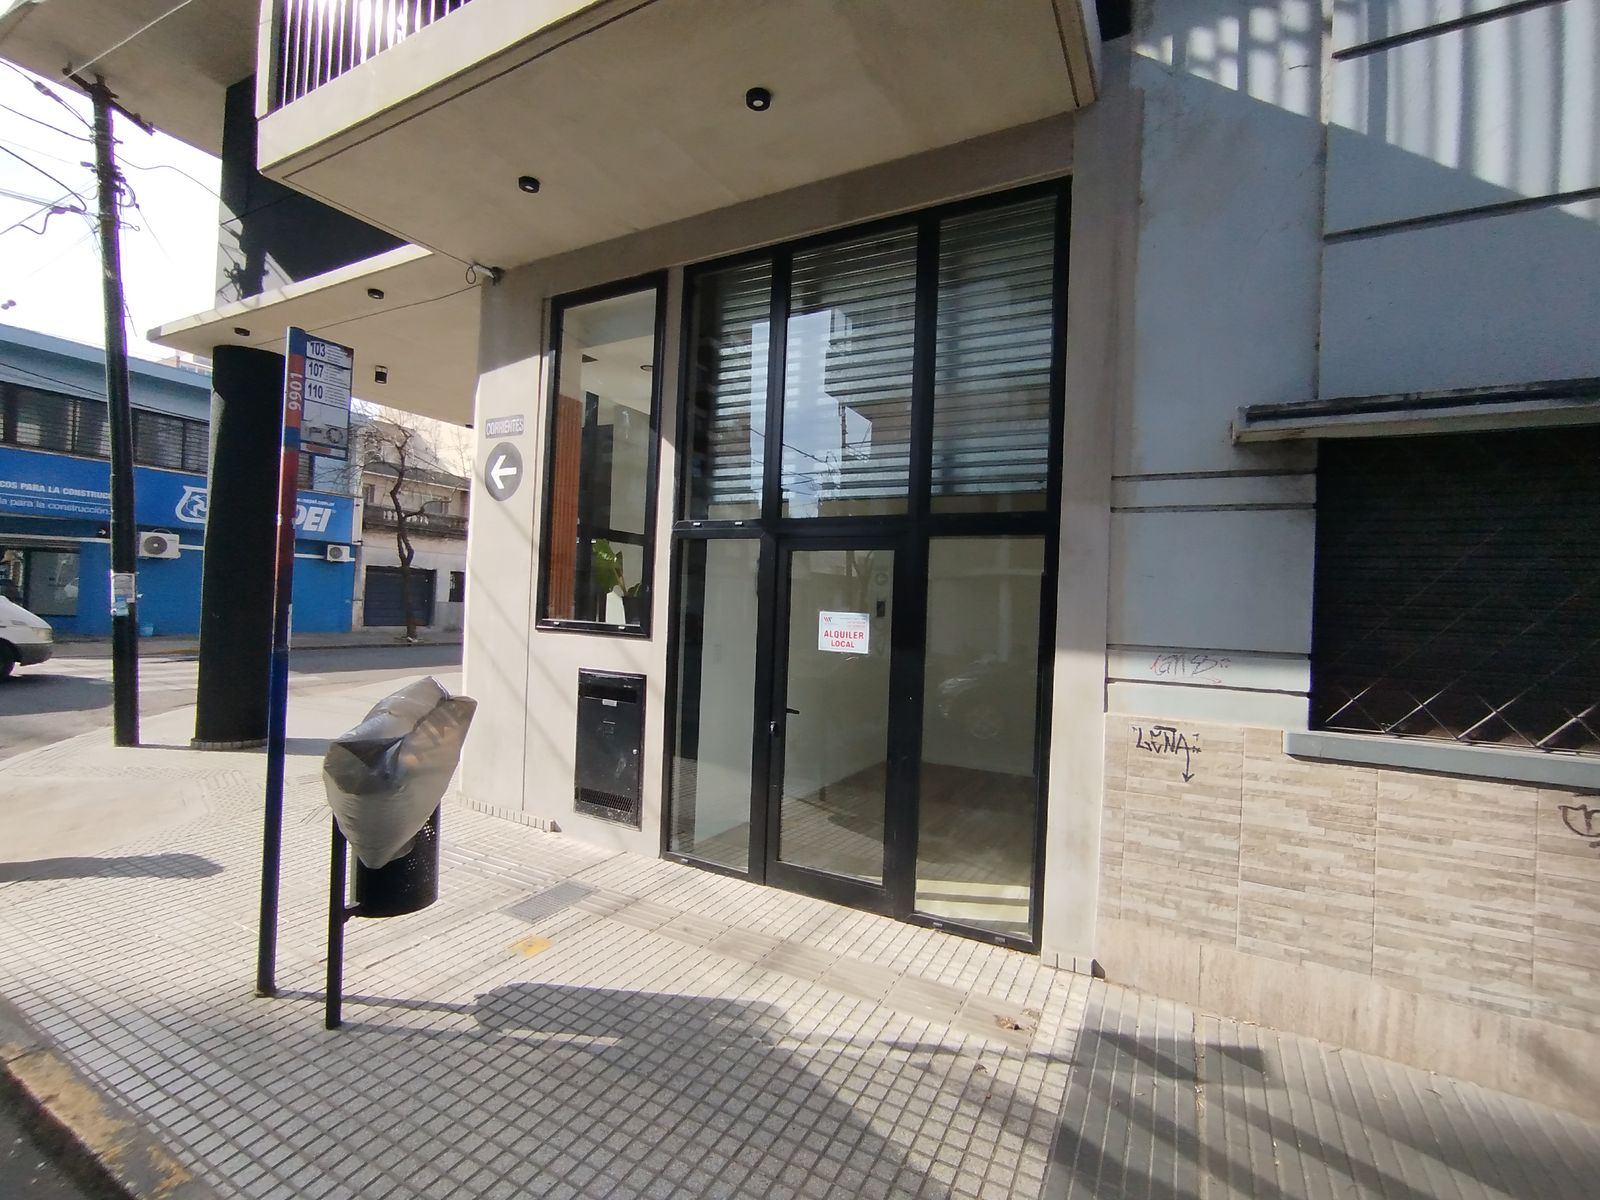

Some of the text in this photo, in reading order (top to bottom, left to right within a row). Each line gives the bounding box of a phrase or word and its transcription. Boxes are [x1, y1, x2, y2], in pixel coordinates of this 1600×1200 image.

[310, 342, 326, 357] 103
[308, 361, 324, 378] 107
[288, 372, 303, 411] 9901
[307, 383, 323, 399] 110
[20, 482, 45, 492] PARA
[48, 485, 60, 494] LA
[823, 630, 865, 640] ALQUILER
[831, 640, 855, 649] LOCAL
